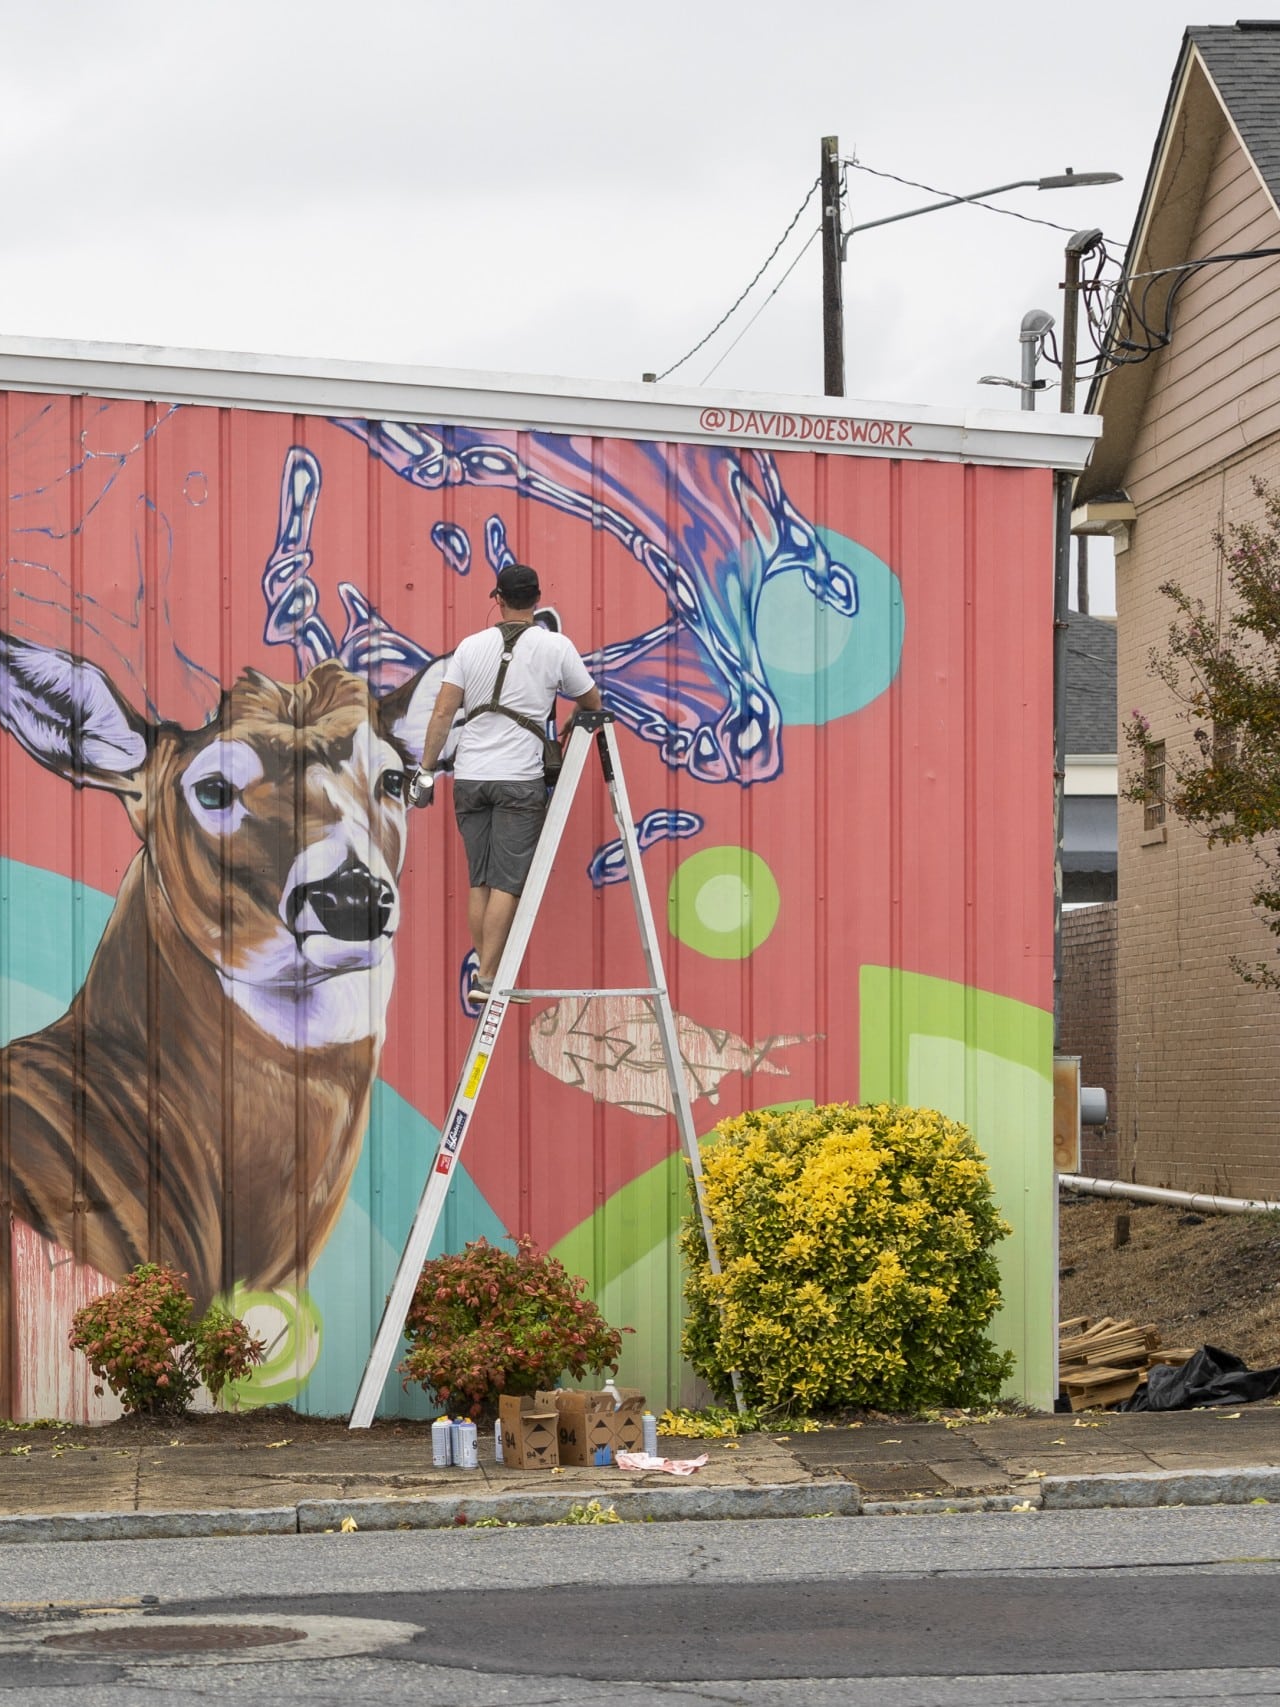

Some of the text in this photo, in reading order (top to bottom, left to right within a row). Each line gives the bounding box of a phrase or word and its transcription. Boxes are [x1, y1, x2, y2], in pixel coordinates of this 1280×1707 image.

[699, 406, 913, 447] @DAVID.DOESWORK
[505, 1431, 516, 1450] 94
[560, 1427, 577, 1446] 94
[527, 1451, 537, 1459] 94
